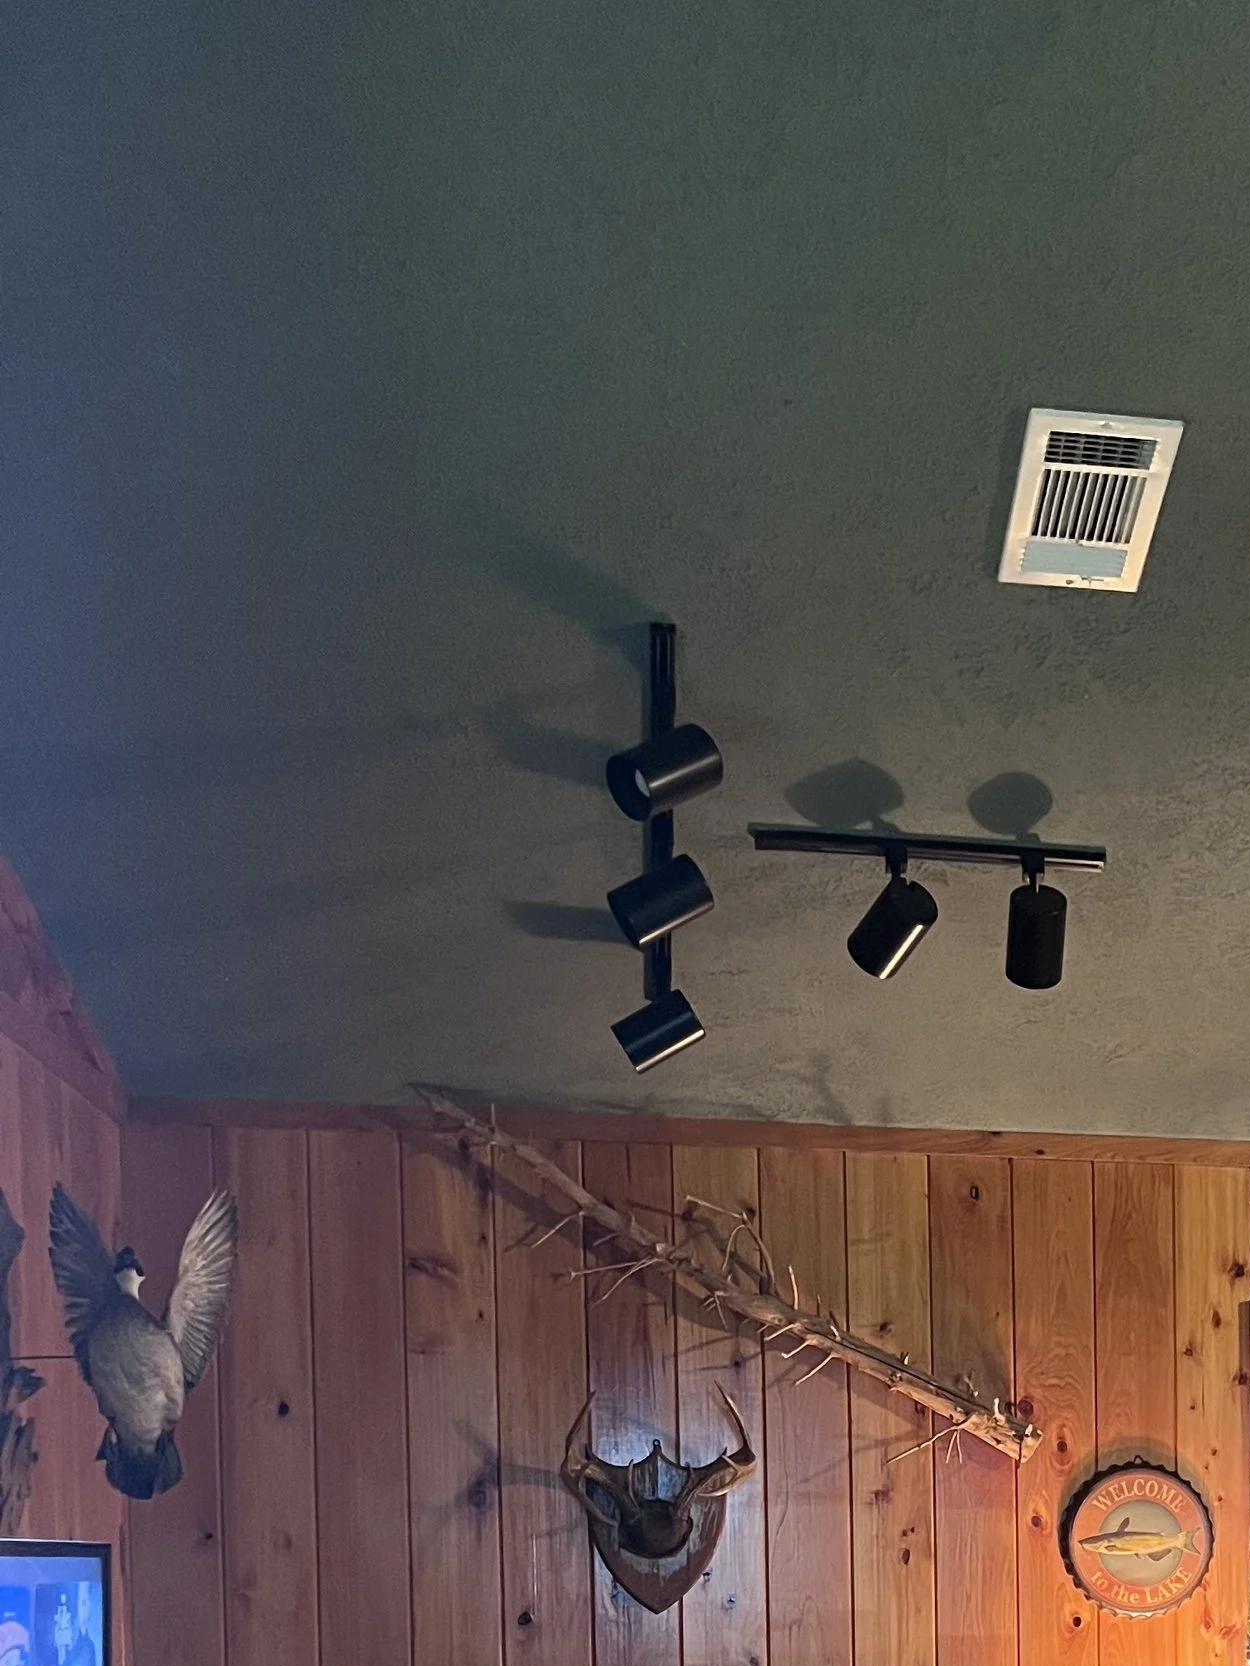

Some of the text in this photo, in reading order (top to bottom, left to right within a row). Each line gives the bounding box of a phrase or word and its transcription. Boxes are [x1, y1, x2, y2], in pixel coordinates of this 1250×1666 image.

[1091, 1479, 1186, 1513] WELCOME
[1091, 1567, 1192, 1604] to the LAKE
